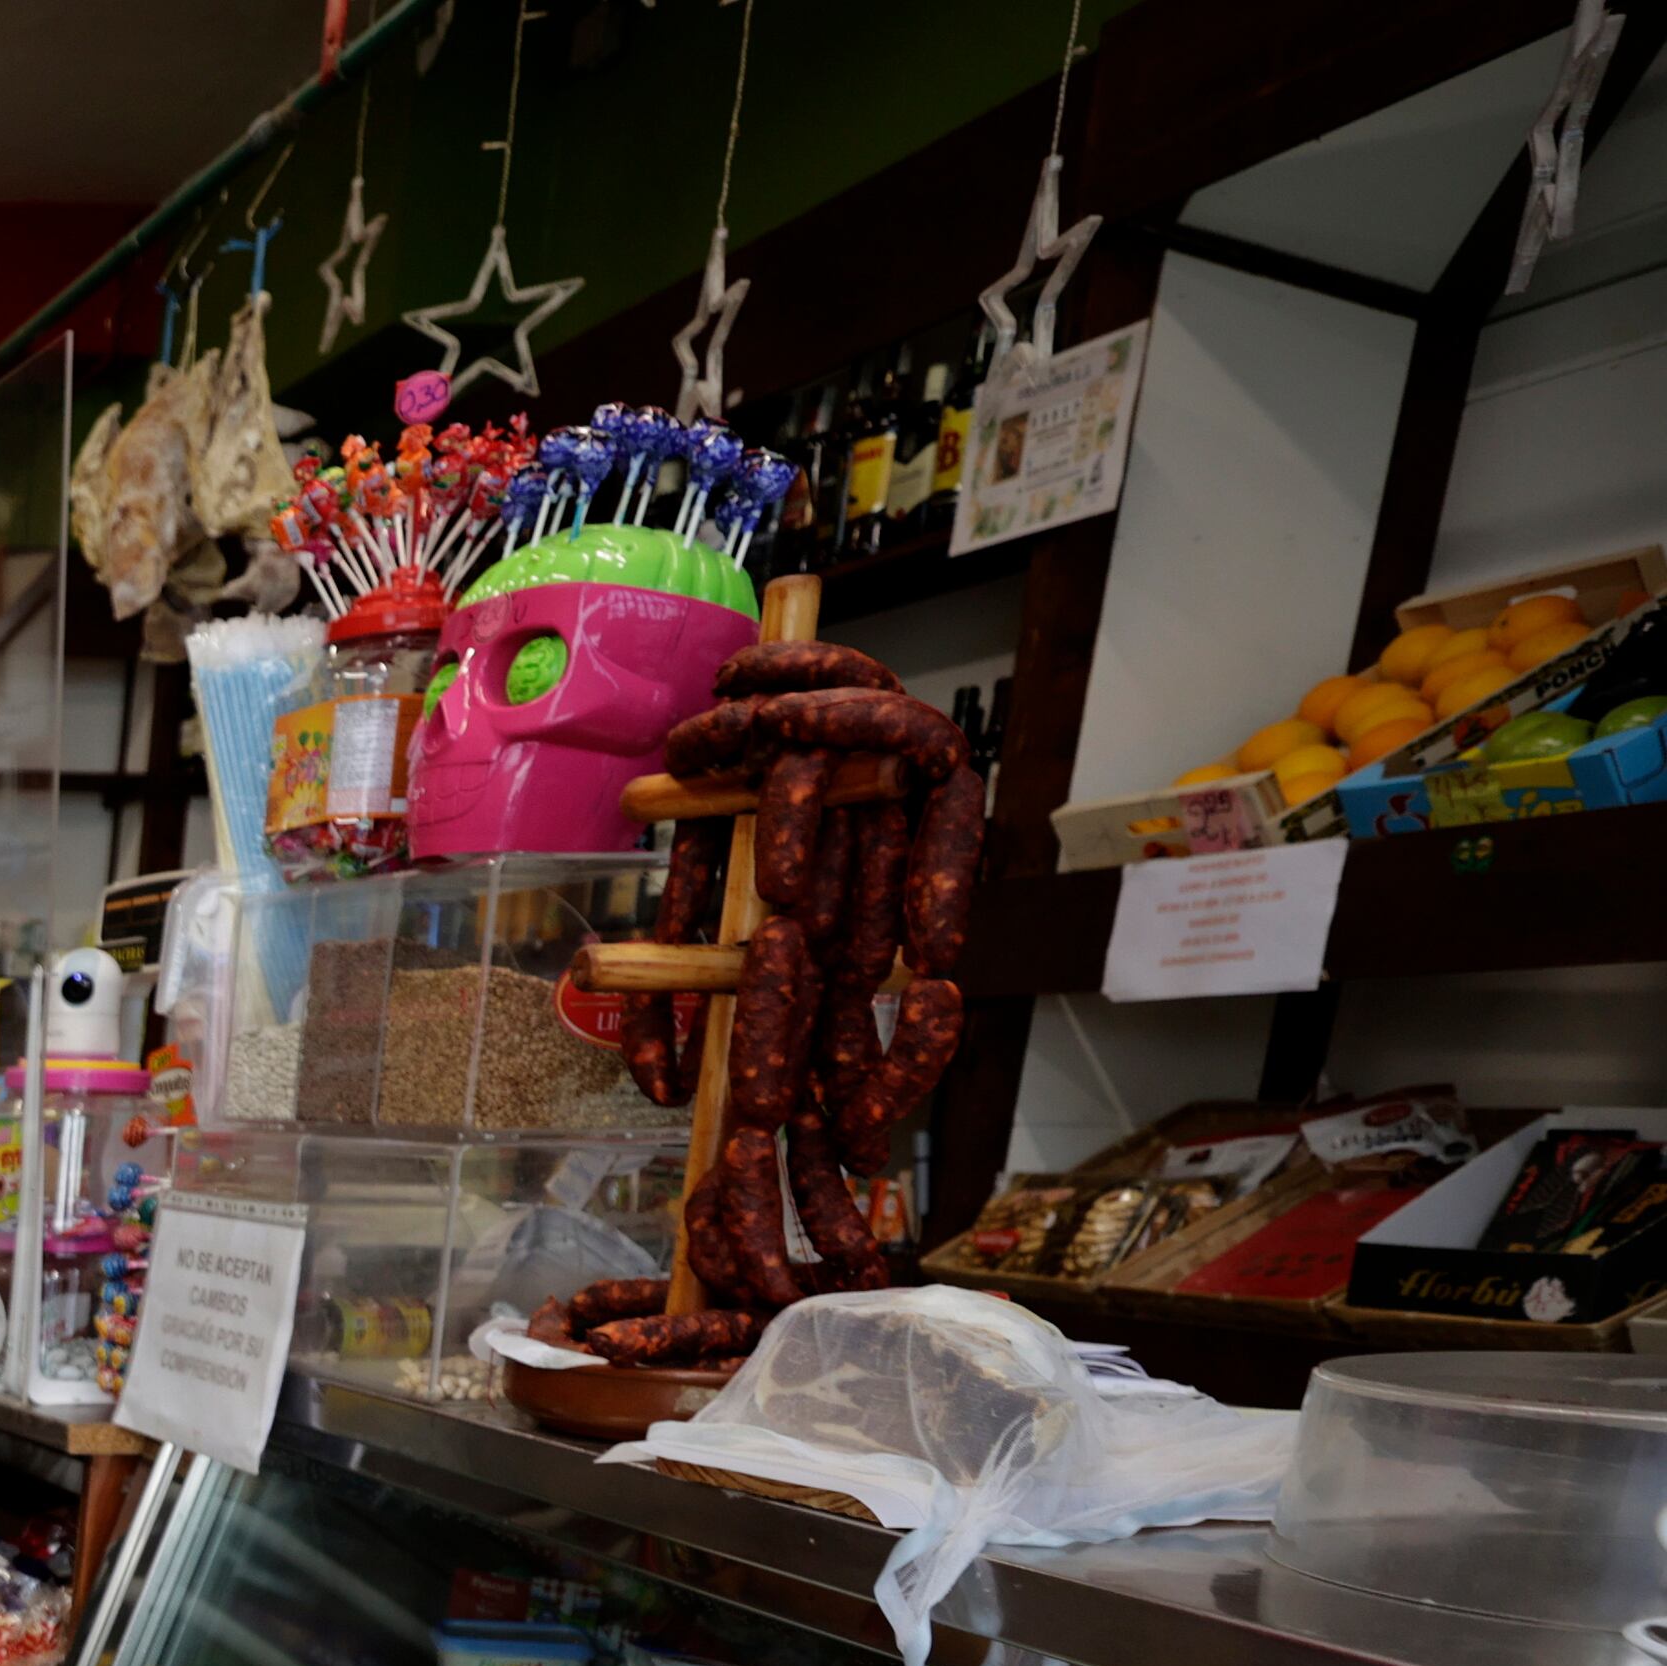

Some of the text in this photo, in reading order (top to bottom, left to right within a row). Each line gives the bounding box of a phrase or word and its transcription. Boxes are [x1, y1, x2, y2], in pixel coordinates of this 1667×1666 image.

[177, 1248, 274, 1286] NO SE ACEPTAN
[189, 1285, 249, 1317] CAMBIOS
